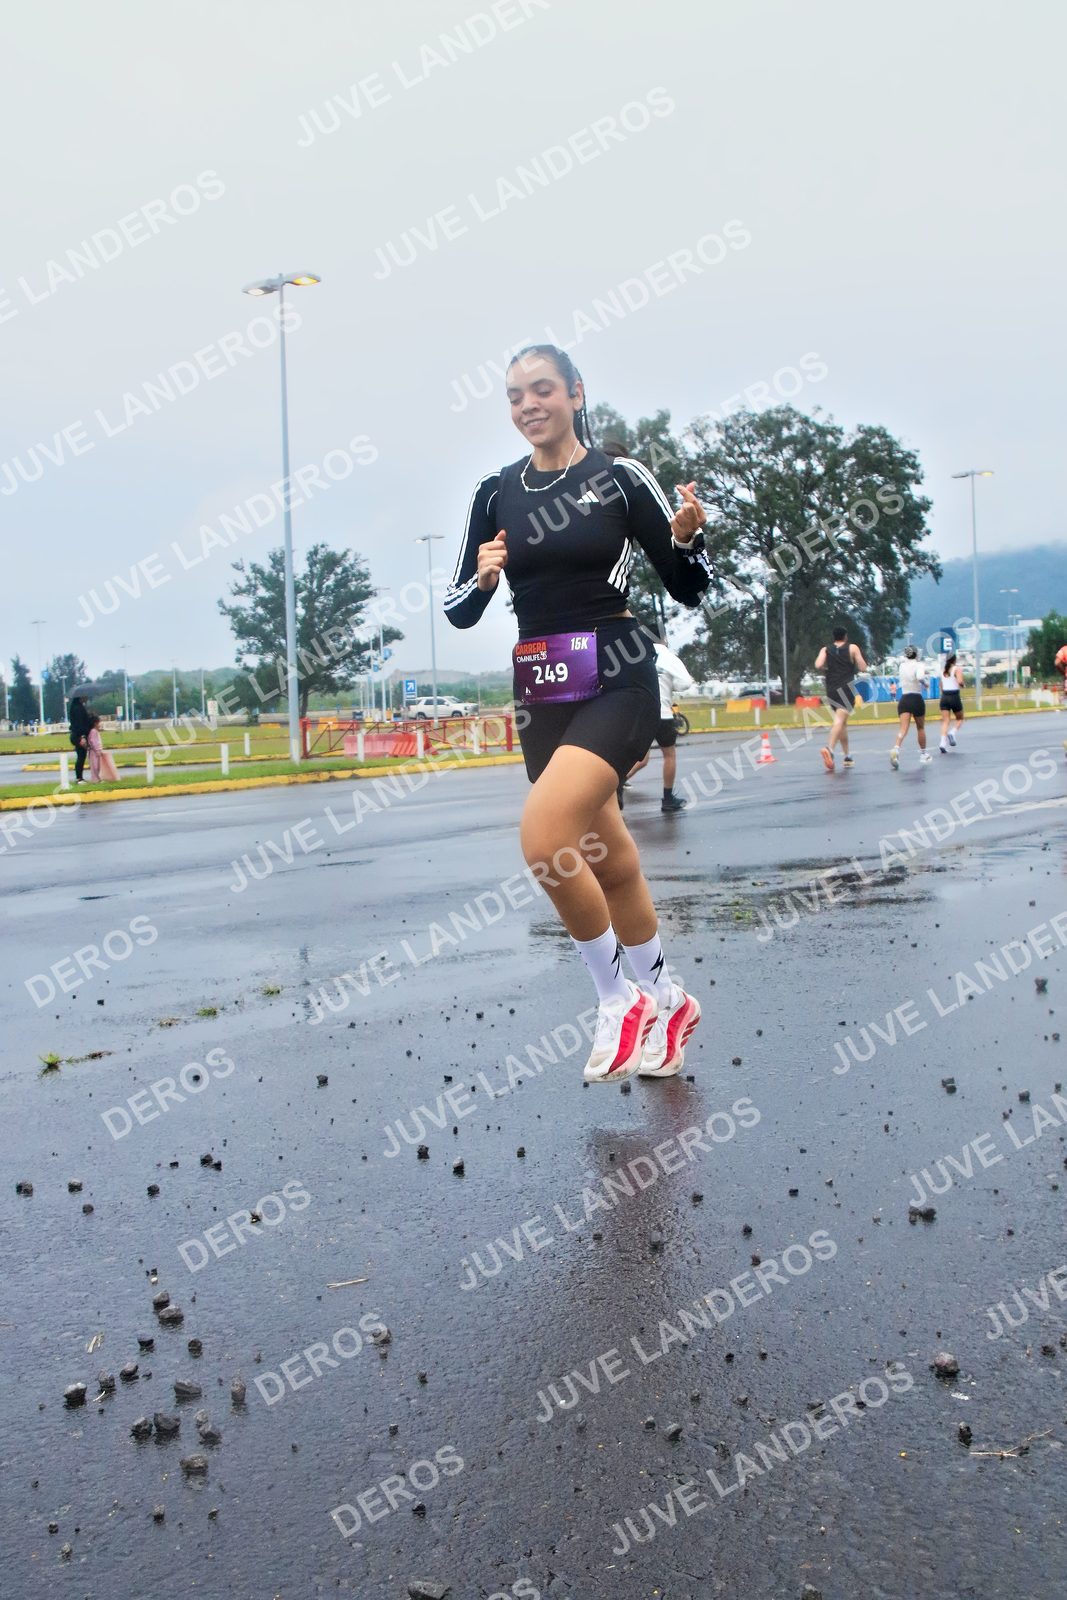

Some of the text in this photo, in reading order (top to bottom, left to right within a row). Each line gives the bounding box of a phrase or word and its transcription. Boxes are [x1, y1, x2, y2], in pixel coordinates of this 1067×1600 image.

[515, 641, 548, 656] CARRERA
[943, 637, 953, 650] E
[532, 662, 569, 685] 249
